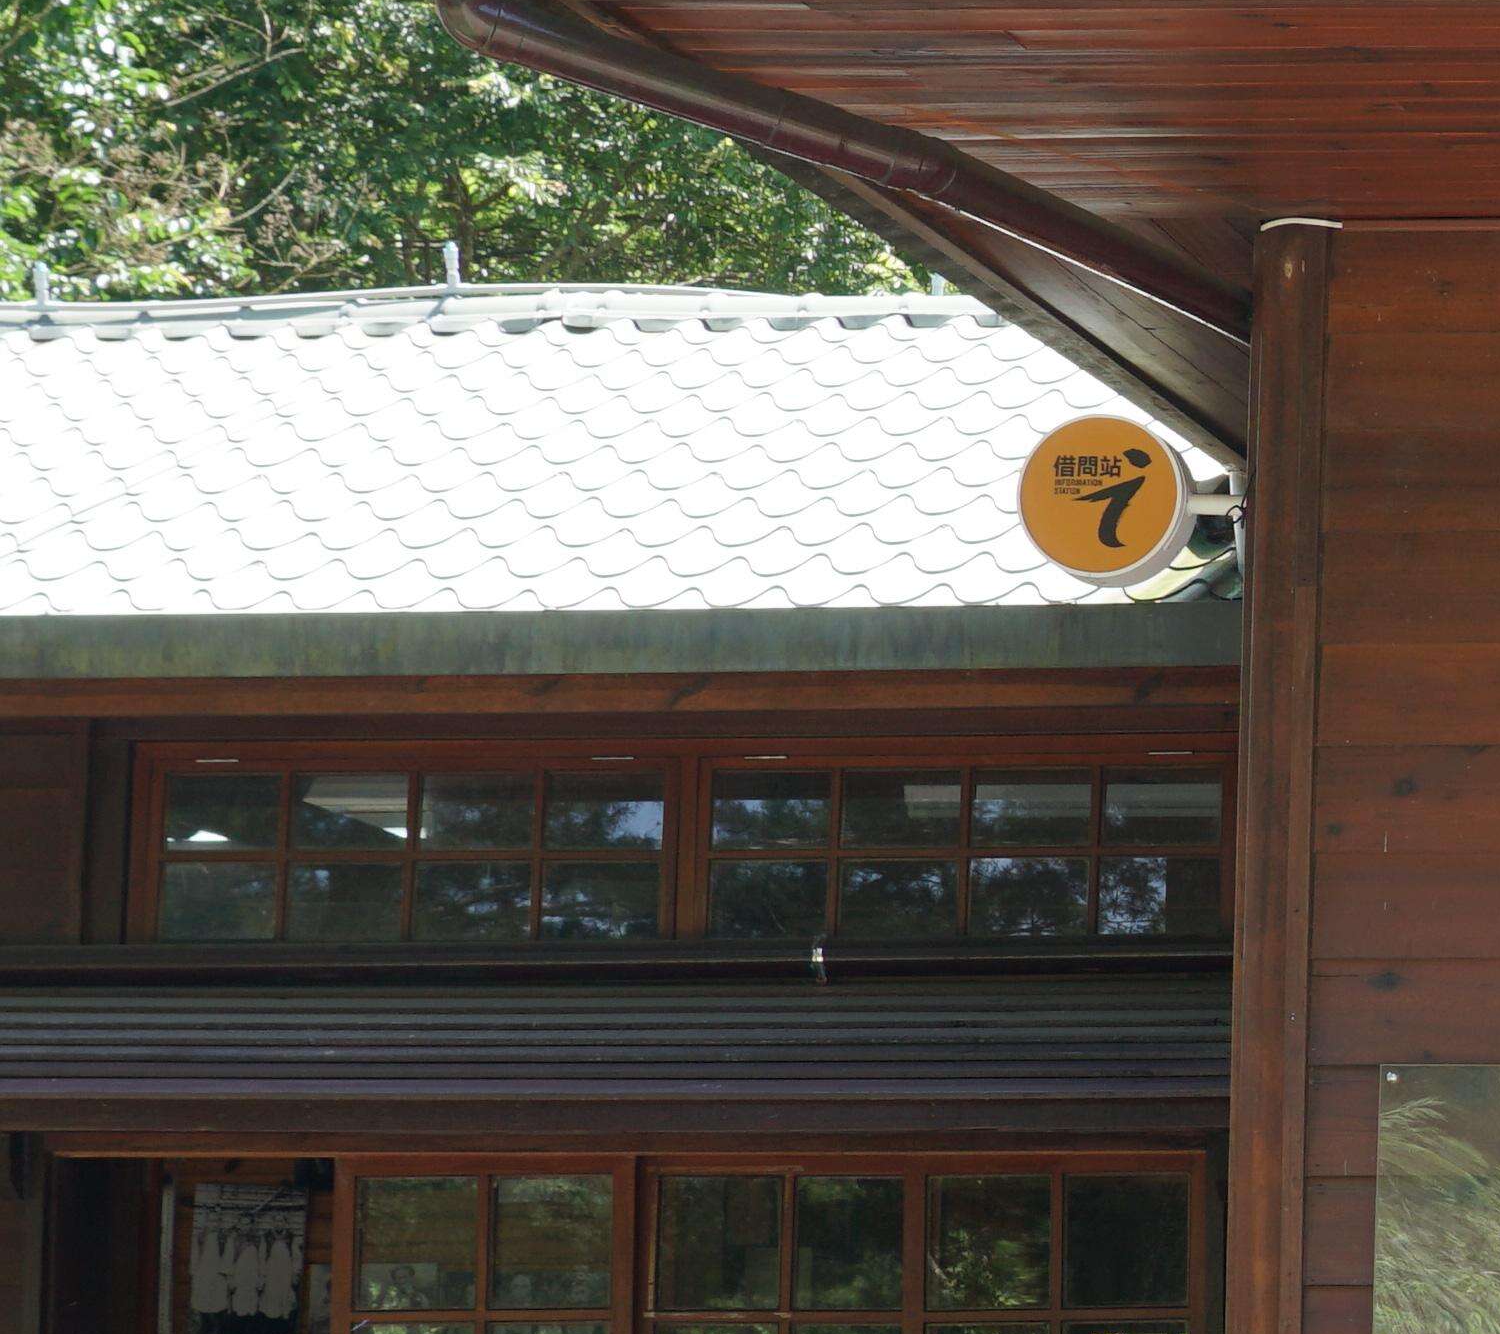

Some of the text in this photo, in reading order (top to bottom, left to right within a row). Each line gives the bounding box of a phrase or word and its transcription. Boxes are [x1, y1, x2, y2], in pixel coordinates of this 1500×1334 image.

[1053, 454, 1122, 478] 借問站
[1054, 487, 1081, 495] STATION
